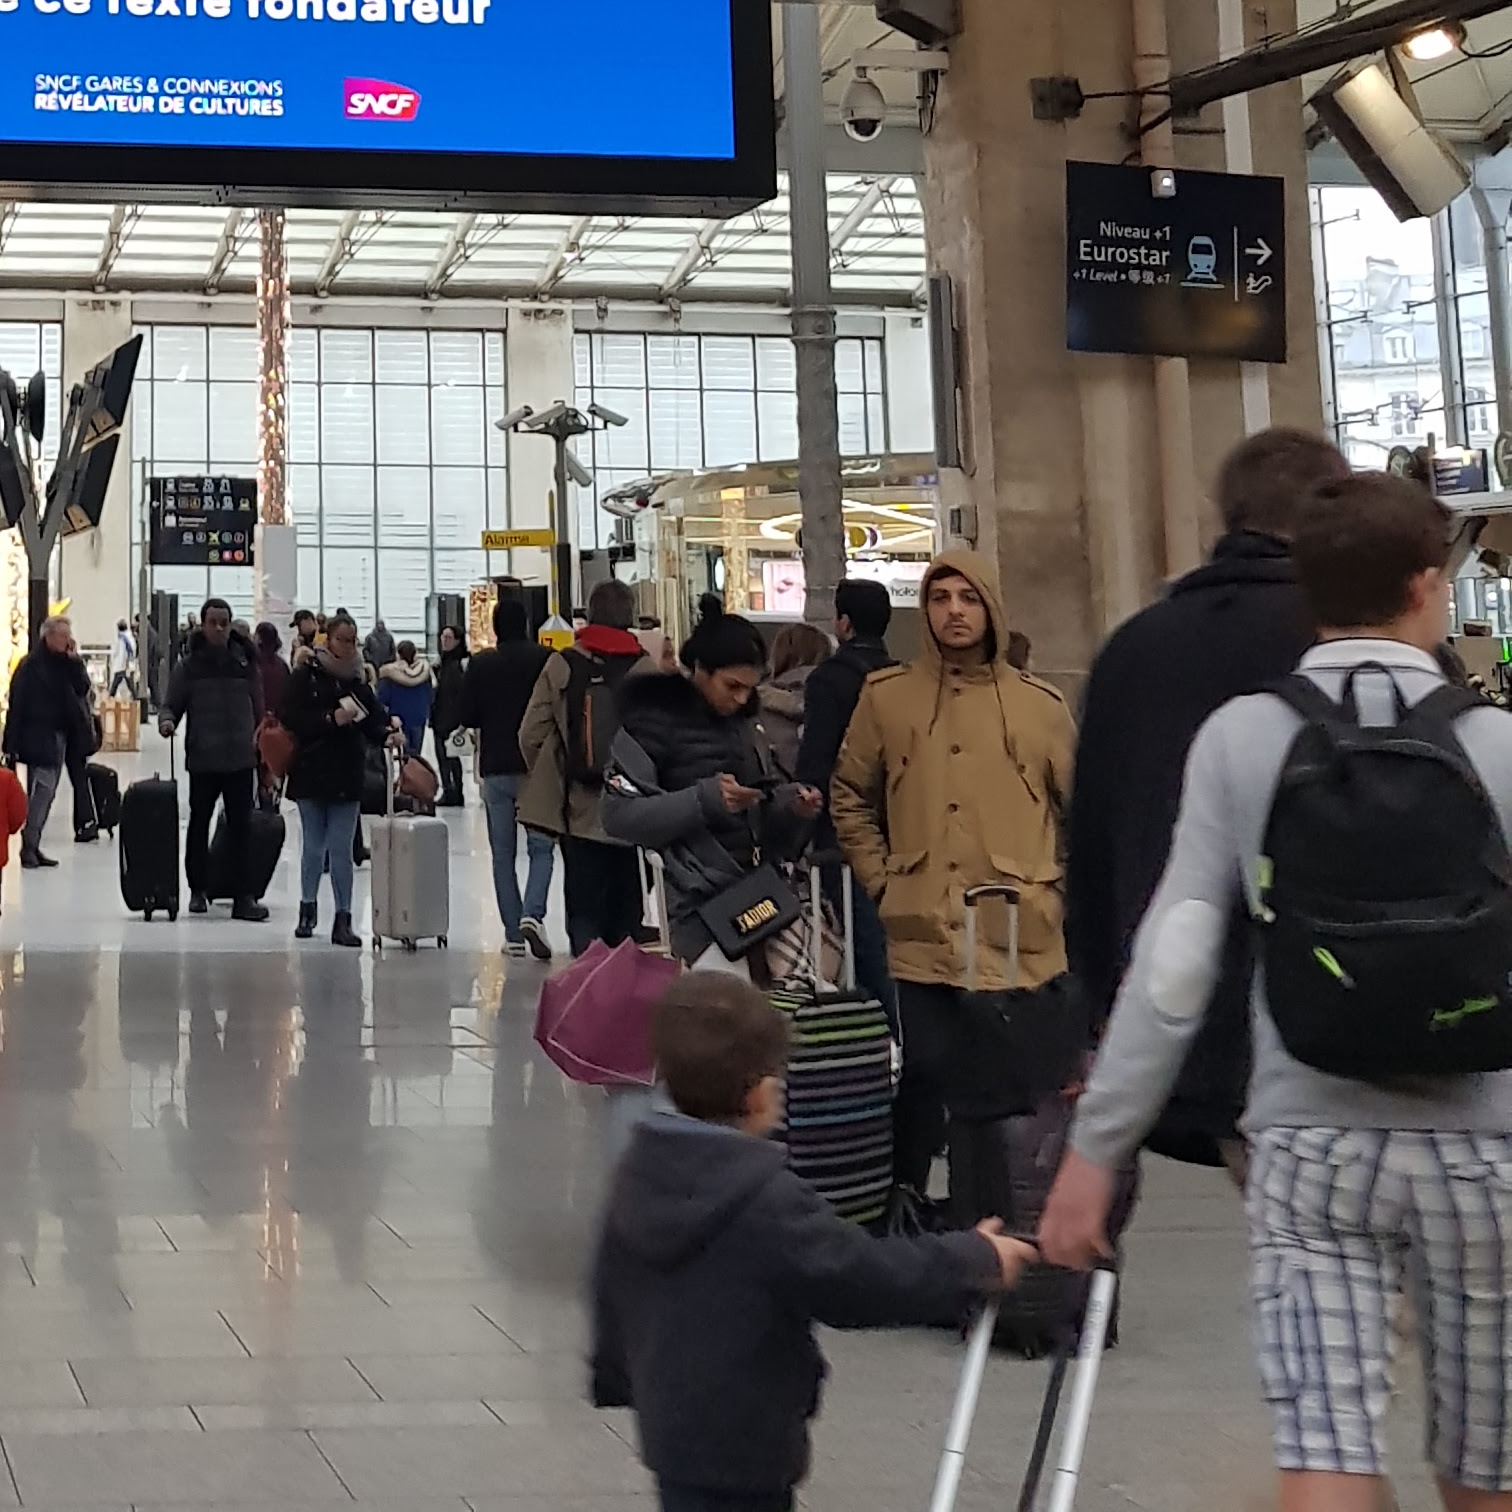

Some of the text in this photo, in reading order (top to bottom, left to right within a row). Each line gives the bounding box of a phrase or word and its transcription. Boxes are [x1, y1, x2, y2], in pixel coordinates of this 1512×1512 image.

[34, 73, 284, 97] SNCF GARES & CONNEXIONS
[34, 91, 285, 117] RÉVÉLATEUR DE CULTURES
[346, 93, 415, 116] SNCF
[1099, 220, 1171, 240] Niveau +1
[1079, 239, 1171, 266] Eurostar
[1089, 267, 1118, 283] Level
